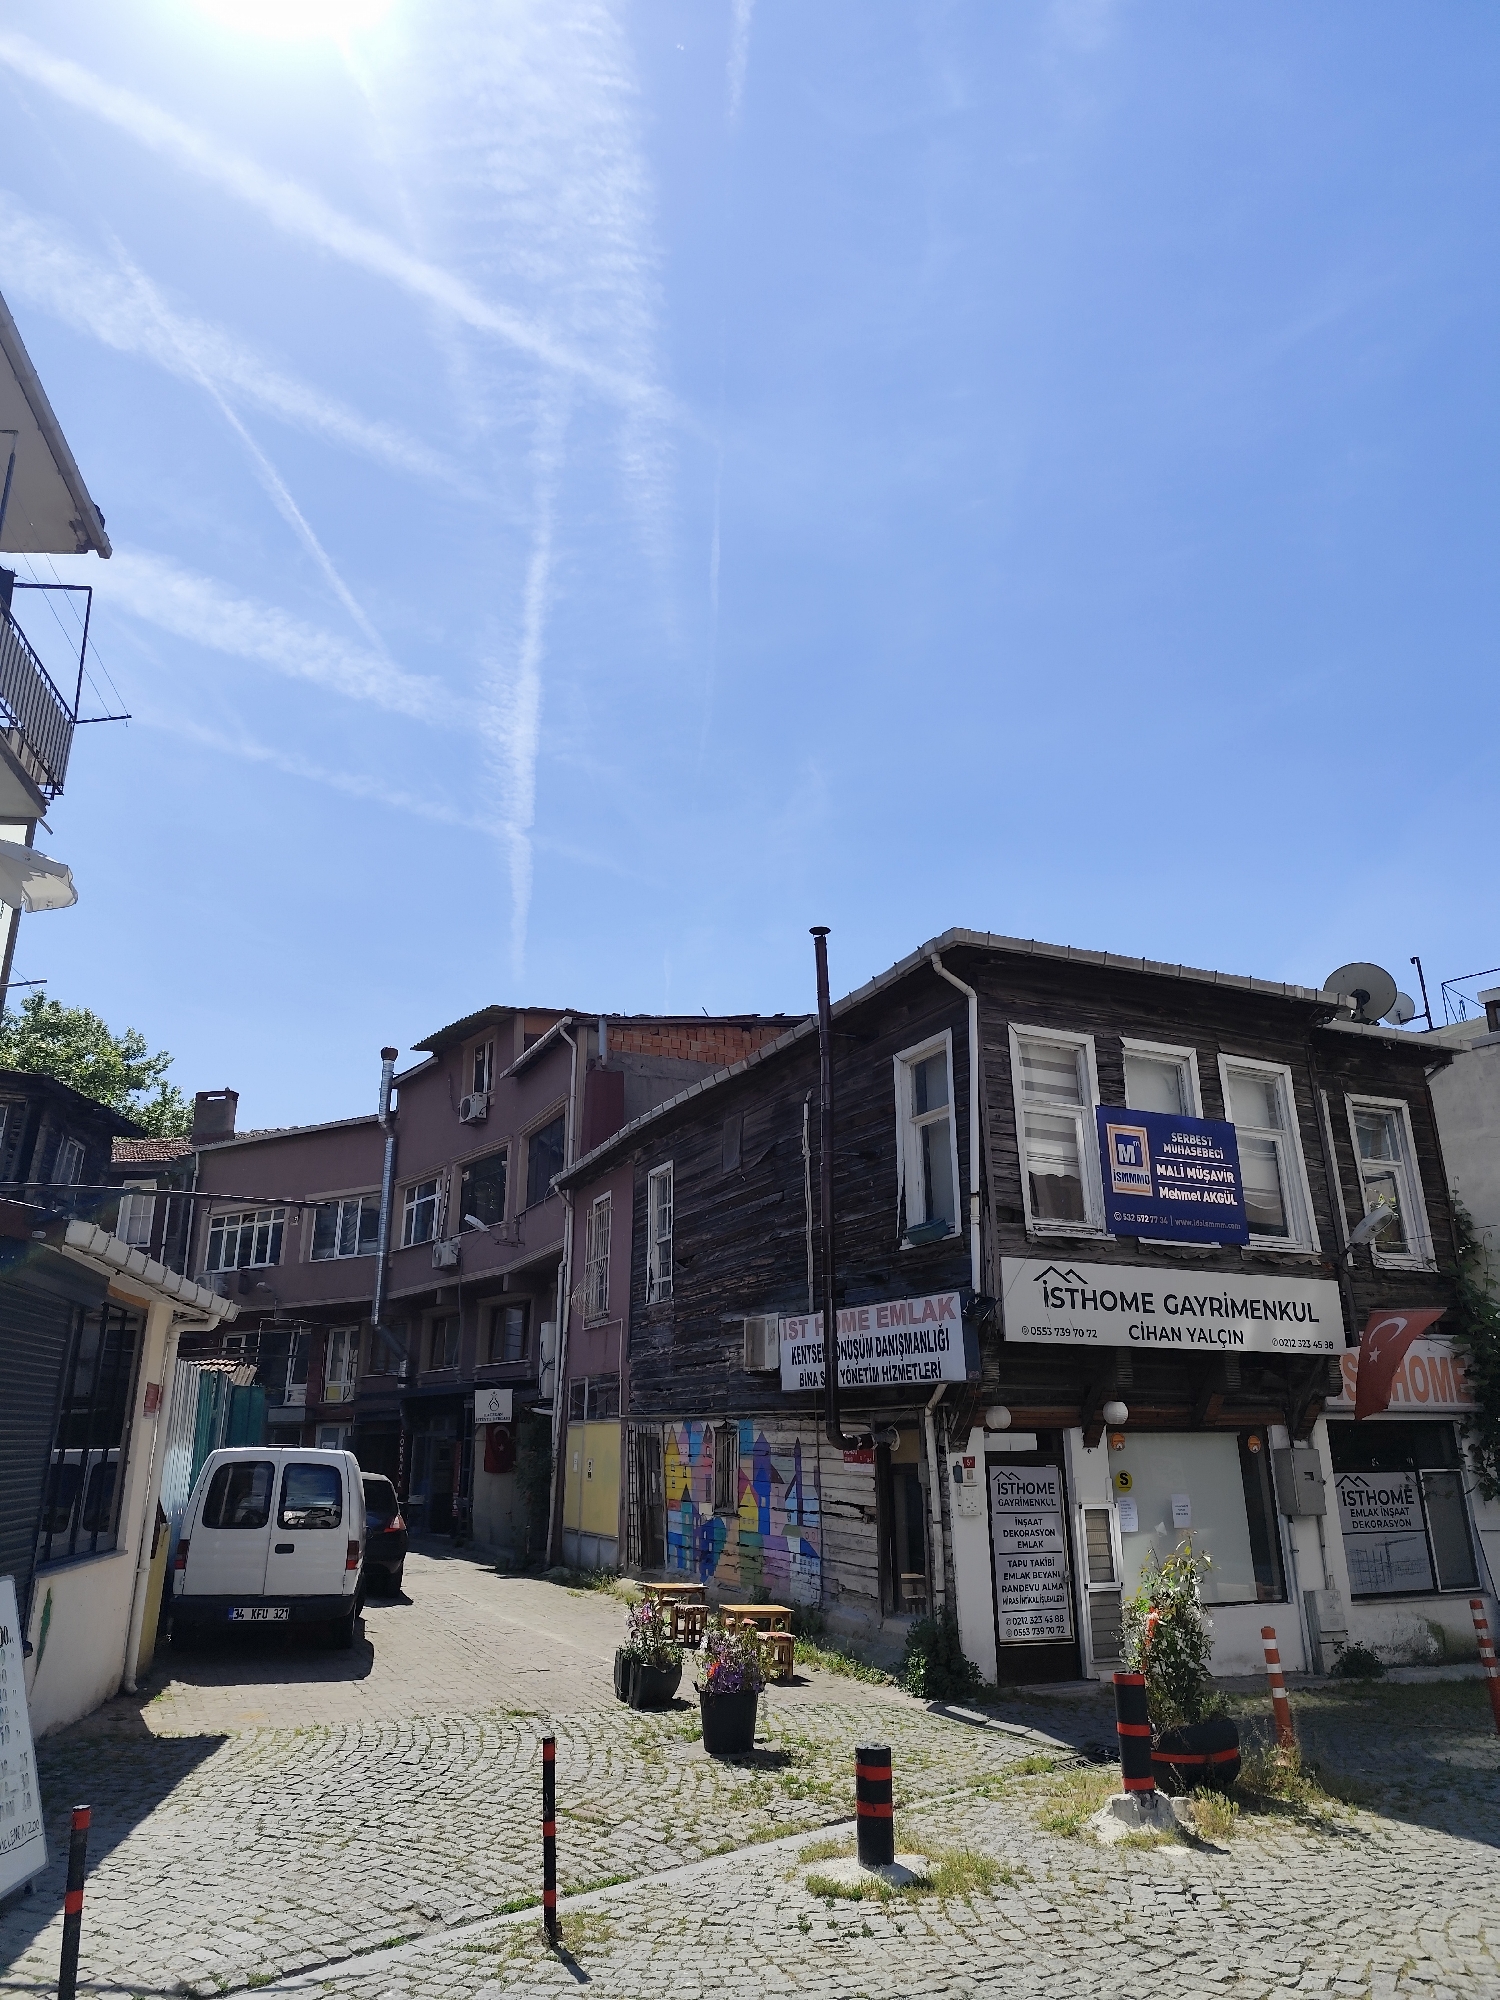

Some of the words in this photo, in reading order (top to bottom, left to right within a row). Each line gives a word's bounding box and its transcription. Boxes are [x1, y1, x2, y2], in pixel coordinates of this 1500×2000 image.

[1171, 1132, 1213, 1146] SERBEST
[1163, 1142, 1224, 1160] MUHASEBECİ
[1156, 1163, 1184, 1178] MALİ
[1187, 1166, 1235, 1184] MÜŞAVİR
[1159, 1186, 1201, 1202] Mehmet
[1203, 1191, 1238, 1206] AKGÜL
[1043, 1280, 1155, 1314] İSTHOME
[1164, 1292, 1319, 1323] GAYRİMENKUL
[783, 1318, 808, 1341] İST
[815, 1309, 870, 1336] HME
[876, 1296, 956, 1328] EMLAK
[1031, 1327, 1052, 1336] 0553
[1054, 1327, 1071, 1337] 739
[1073, 1328, 1084, 1337] 70
[1087, 1329, 1098, 1338] 72
[1129, 1321, 1182, 1342] CİHAN
[1186, 1327, 1244, 1348] YALÇIN
[875, 1323, 949, 1361] DANIŞMANLIĞI
[800, 1369, 818, 1387] BİNA
[840, 1363, 880, 1385] YÖNETİM
[882, 1356, 942, 1382] HİZMETLERİ
[997, 1479, 1056, 1495] İSTHOME
[998, 1496, 1057, 1507] GAYRİMENKUL
[1341, 1485, 1415, 1507] İSTHOME
[1350, 1508, 1379, 1518] EMLAK
[1380, 1506, 1410, 1518] İNŞAAT
[1015, 1517, 1043, 1527] İNŞAAT
[1352, 1519, 1412, 1529] DEKORASYON
[1003, 1529, 1056, 1538] DEKORASYON
[1017, 1540, 1044, 1549] EMLAK
[1007, 1560, 1028, 1568] TAPU
[1030, 1557, 1055, 1567] TAKİBİ
[1004, 1572, 1031, 1580] EMLAK
[1002, 1584, 1040, 1593] RANDEVU
[1042, 1583, 1064, 1591] ALMA
[234, 1609, 244, 1619] 34
[251, 1609, 269, 1620] KFU
[273, 1609, 289, 1620] 321
[1013, 1617, 1028, 1625] 0212
[1030, 1616, 1042, 1624] 323
[1014, 1628, 1030, 1637] 0553
[1032, 1627, 1045, 1635] 739
[1056, 1626, 1065, 1634] 72
